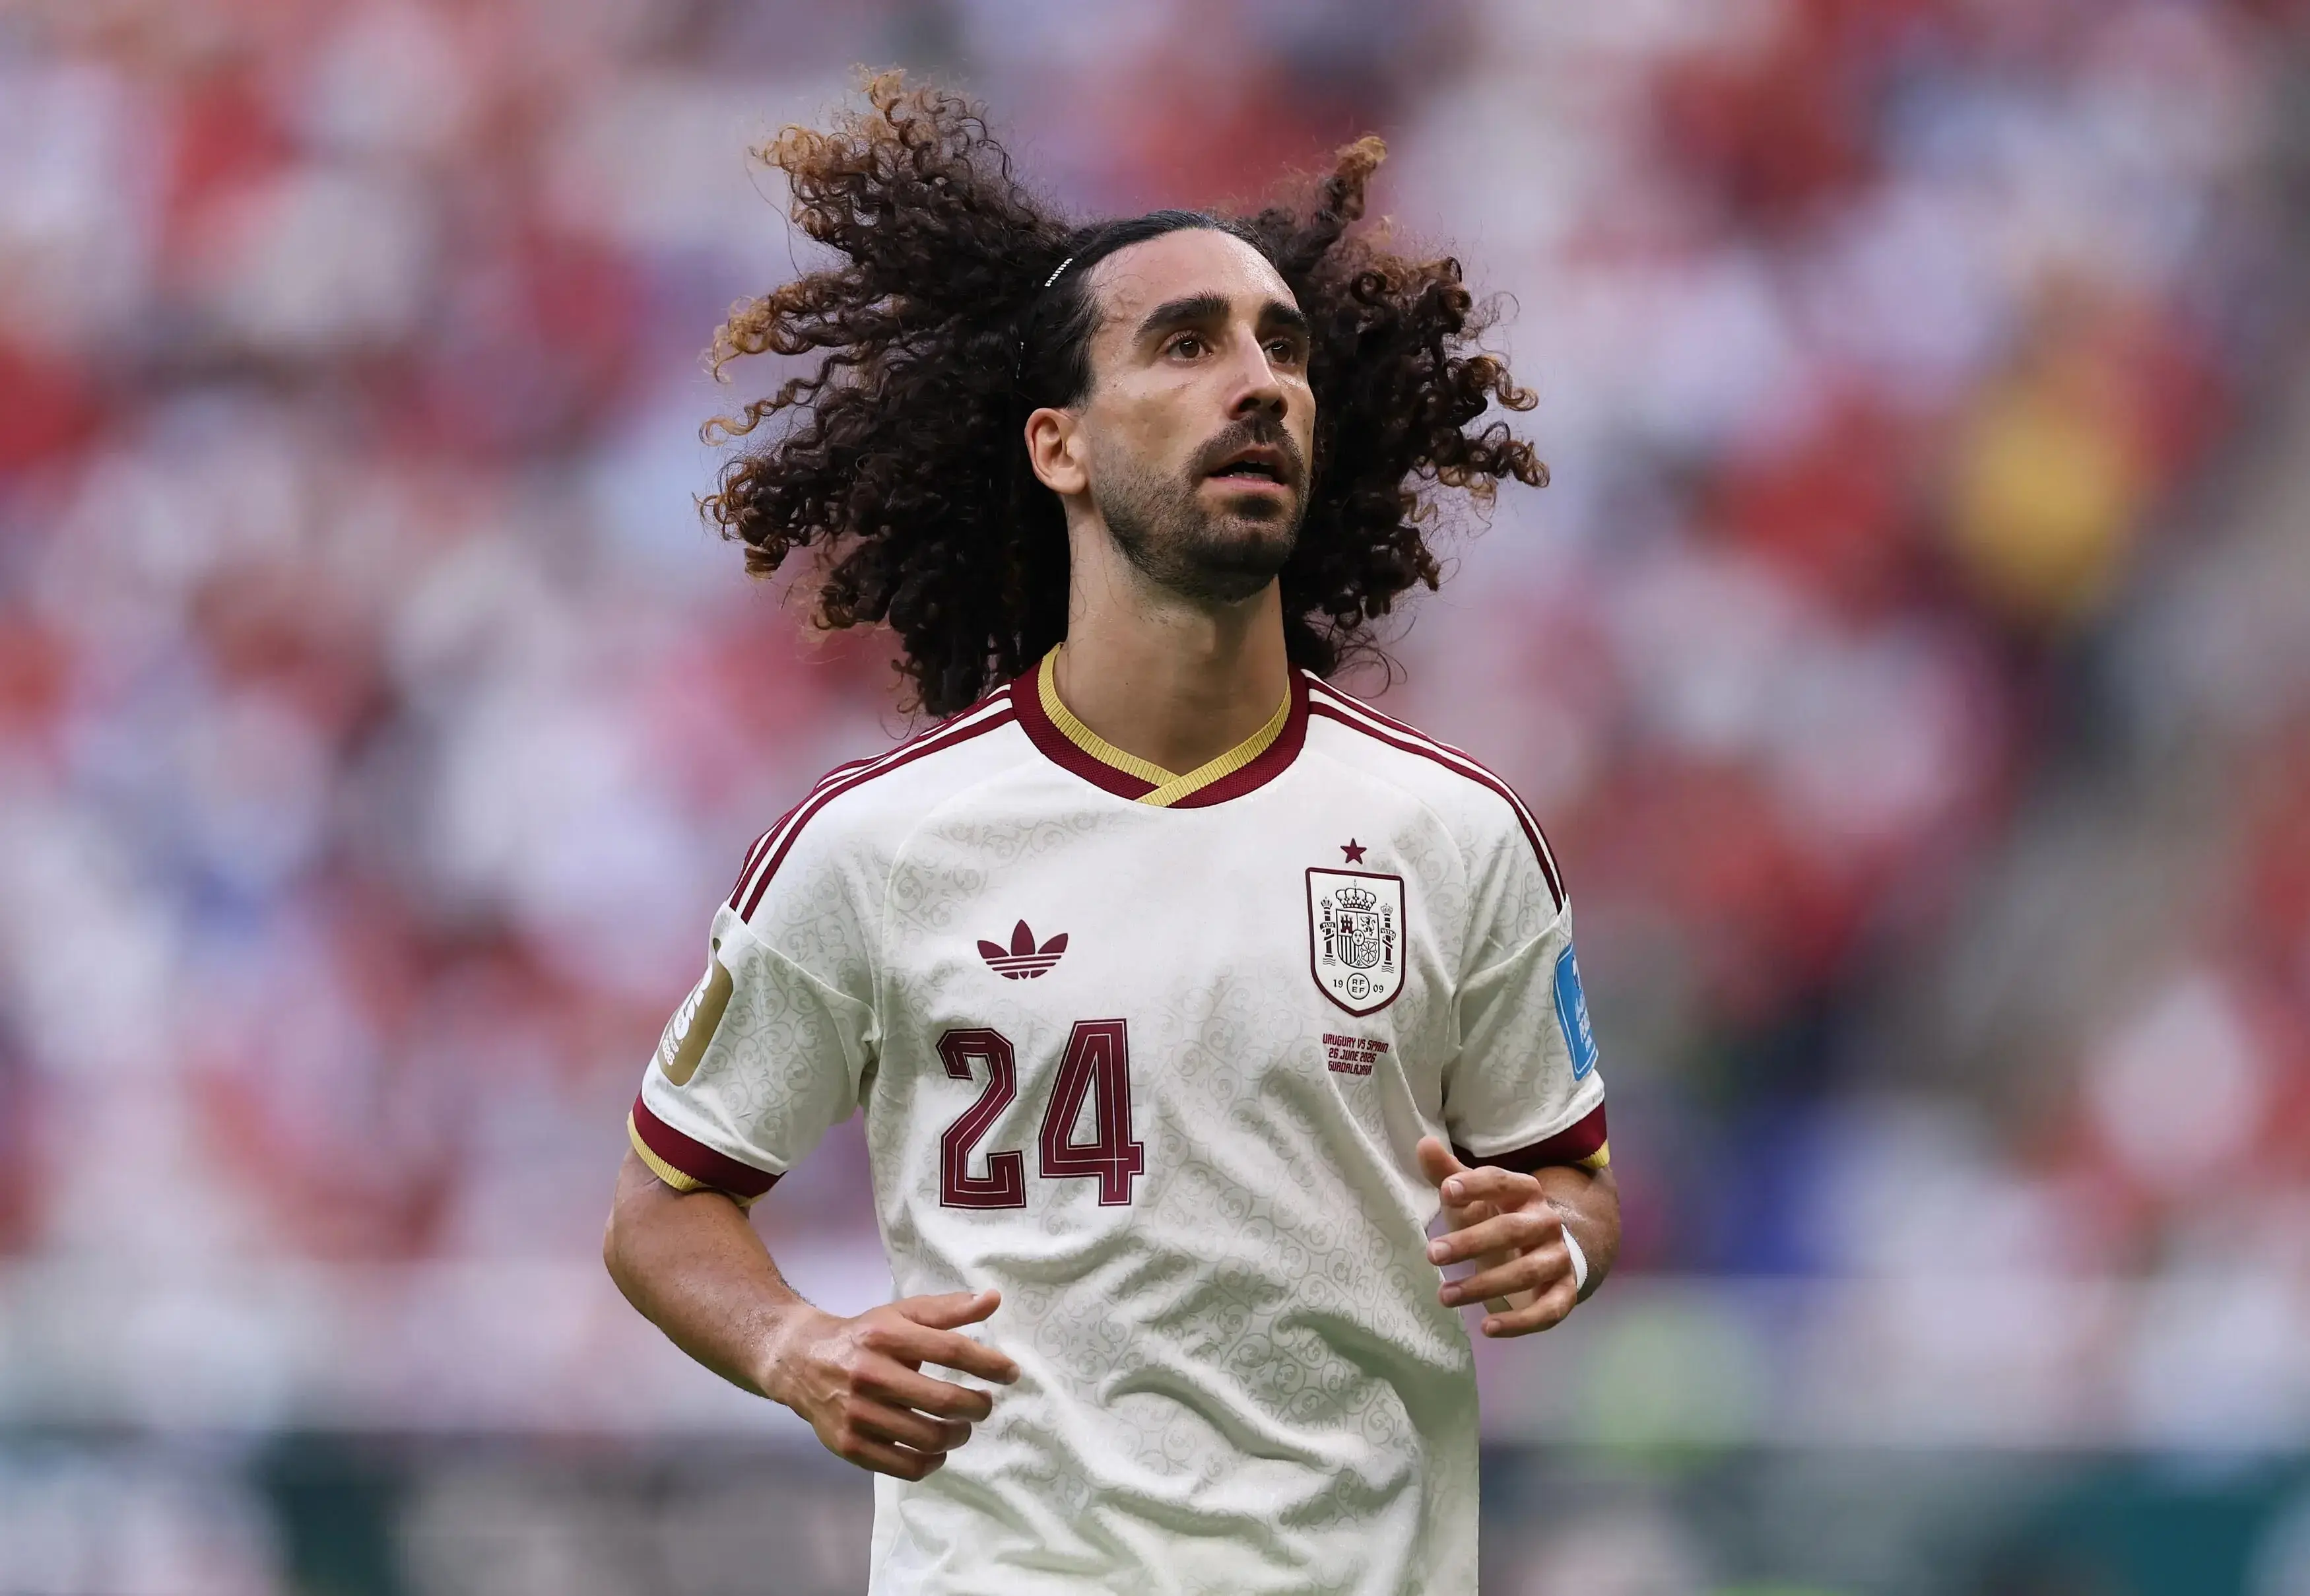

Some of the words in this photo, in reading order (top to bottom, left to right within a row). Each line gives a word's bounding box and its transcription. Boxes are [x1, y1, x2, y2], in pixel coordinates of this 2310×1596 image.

[1333, 979, 1343, 988] 19
[1373, 984, 1384, 993] 09
[1323, 1033, 1356, 1048] URUGUAY
[1357, 1038, 1366, 1049] VS
[1366, 1040, 1389, 1053] SPAIN
[1329, 1047, 1339, 1059] 26
[1340, 1049, 1360, 1062] JUNE
[1360, 1052, 1377, 1063] 2026
[1328, 1061, 1372, 1076] GUADALAJARA
[935, 1018, 1144, 1209] 24
